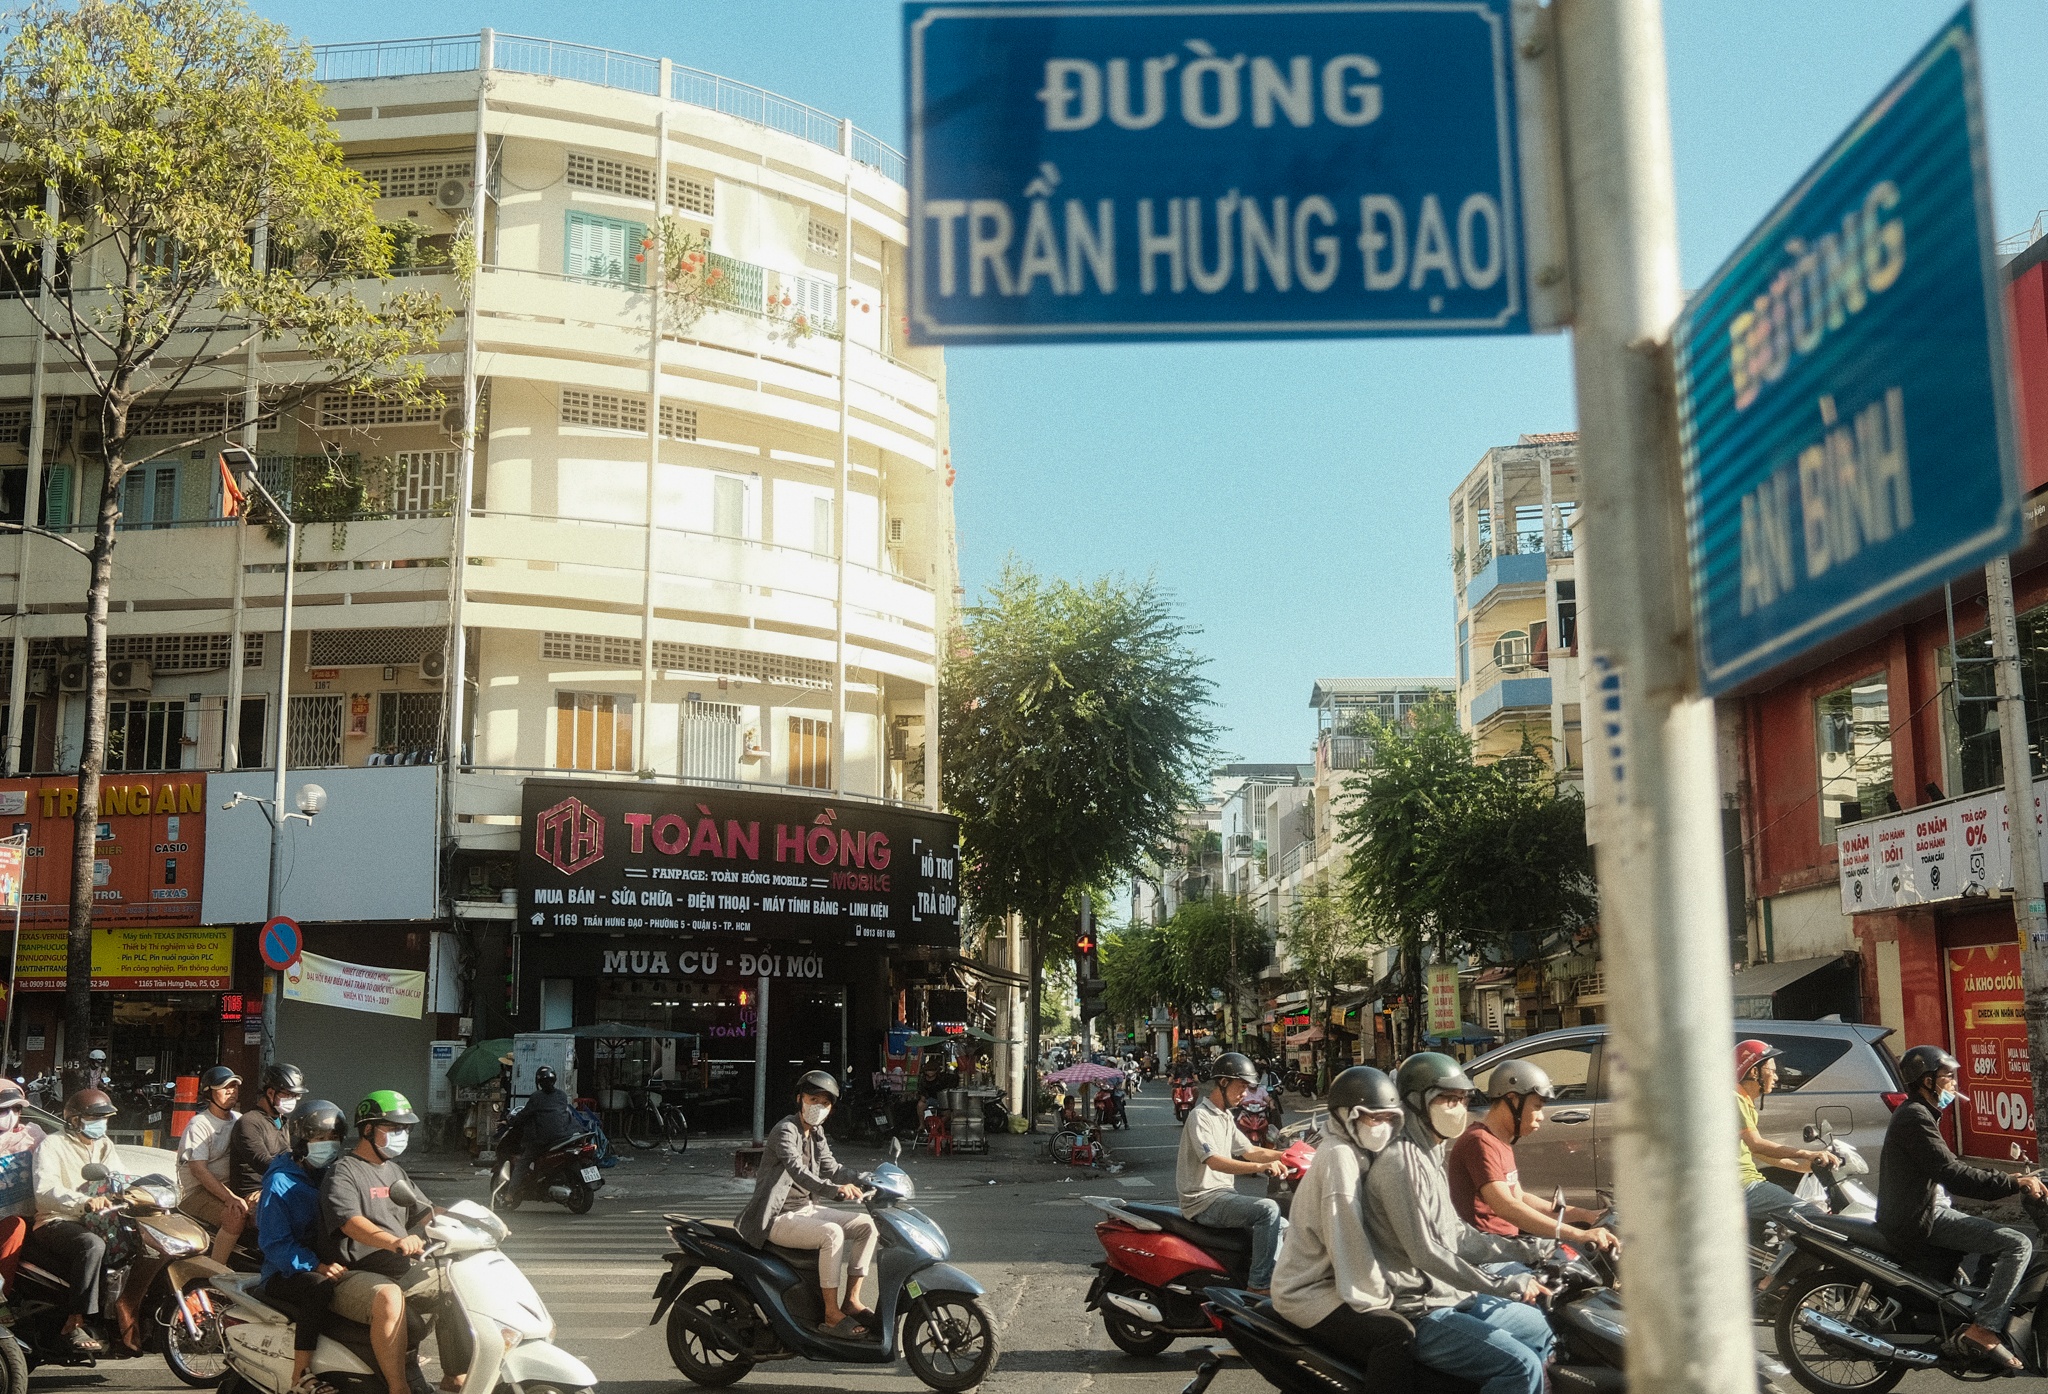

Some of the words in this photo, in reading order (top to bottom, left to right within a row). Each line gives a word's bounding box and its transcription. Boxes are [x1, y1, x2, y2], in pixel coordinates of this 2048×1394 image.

[1036, 38, 1384, 131] ĐƯỜNG
[923, 161, 1118, 297] TRẦN
[1137, 188, 1340, 294] HƯNG
[1357, 193, 1502, 314] ĐẠO
[1739, 466, 1796, 616] AN
[314, 681, 330, 689] 1167
[39, 784, 150, 818] TRNG
[155, 783, 202, 815] AN
[1974, 808, 1987, 820] GÓP
[1890, 828, 1905, 840] HÀNH
[1916, 823, 1926, 837] 05
[1928, 816, 1948, 834] NĂM
[1966, 824, 1987, 846] 0%
[624, 802, 760, 860] TOÀN
[775, 808, 891, 870] HỒNG
[1843, 841, 1850, 853] 10
[1851, 834, 1870, 852] NĂM
[1929, 837, 1945, 849] HÀNH
[154, 844, 188, 853] CASIO
[1900, 847, 1903, 860] 1
[1921, 853, 1934, 864] TOÀN
[921, 850, 934, 877] HỖ
[936, 855, 953, 885] TRỢ
[1857, 865, 1869, 877] QUỐC
[652, 868, 708, 881] FANPAGE:
[711, 869, 739, 882] TOÀN
[741, 870, 770, 885] HỒNG
[772, 875, 808, 887] MOBILE
[831, 871, 891, 892] MOBILE
[152, 888, 188, 898] TEXAS
[918, 886, 936, 915] TRẢ
[938, 888, 957, 916] GÓP
[534, 889, 563, 904] MUA
[568, 887, 595, 904] BÁN
[612, 886, 637, 906] SỬA
[641, 890, 673, 907] CHỮA
[687, 892, 715, 911] ĐIỆN
[718, 895, 750, 913] THOẠI
[763, 895, 785, 912] MÁY
[788, 896, 810, 914] TÍNH
[813, 897, 839, 916] BẢNG
[849, 902, 868, 918] LINH
[870, 902, 889, 920] KIỆN
[553, 914, 577, 926] 1169
[583, 915, 603, 927] TRẦN
[605, 917, 625, 927] HƯNG
[628, 918, 643, 929] ĐẠO
[650, 917, 679, 929] PHƯỜNG
[680, 920, 685, 929] 5
[692, 919, 711, 931] QUẬN
[712, 921, 717, 930] 5
[724, 922, 734, 930] TP.
[736, 922, 750, 931] HCM
[863, 928, 876, 937] 0913
[161, 943, 185, 952] nghiệm
[133, 965, 149, 973] công
[211, 964, 228, 973] dụng
[603, 951, 670, 974] MUA
[679, 947, 719, 974] CŨ
[740, 944, 781, 977] ĐỔI
[787, 950, 824, 978] MỚI
[1964, 974, 1975, 992] XẢ
[1976, 976, 1994, 991] KHO
[1995, 970, 2016, 990] CUỐI
[1978, 1009, 1999, 1018] CHECK-IN
[2001, 1007, 2014, 1019] NHẬN
[709, 1023, 746, 1037] TOÀN
[2008, 1048, 2018, 1058] MUA
[2019, 1048, 2029, 1059] VAL
[1974, 1058, 1997, 1074] 689K
[2008, 1059, 2021, 1074] TẶNG
[2022, 1062, 2031, 1072] VAL
[1974, 1090, 1995, 1115] VALI
[1996, 1092, 2027, 1130] 0Đ
[1560, 1368, 1596, 1387] HONDA
